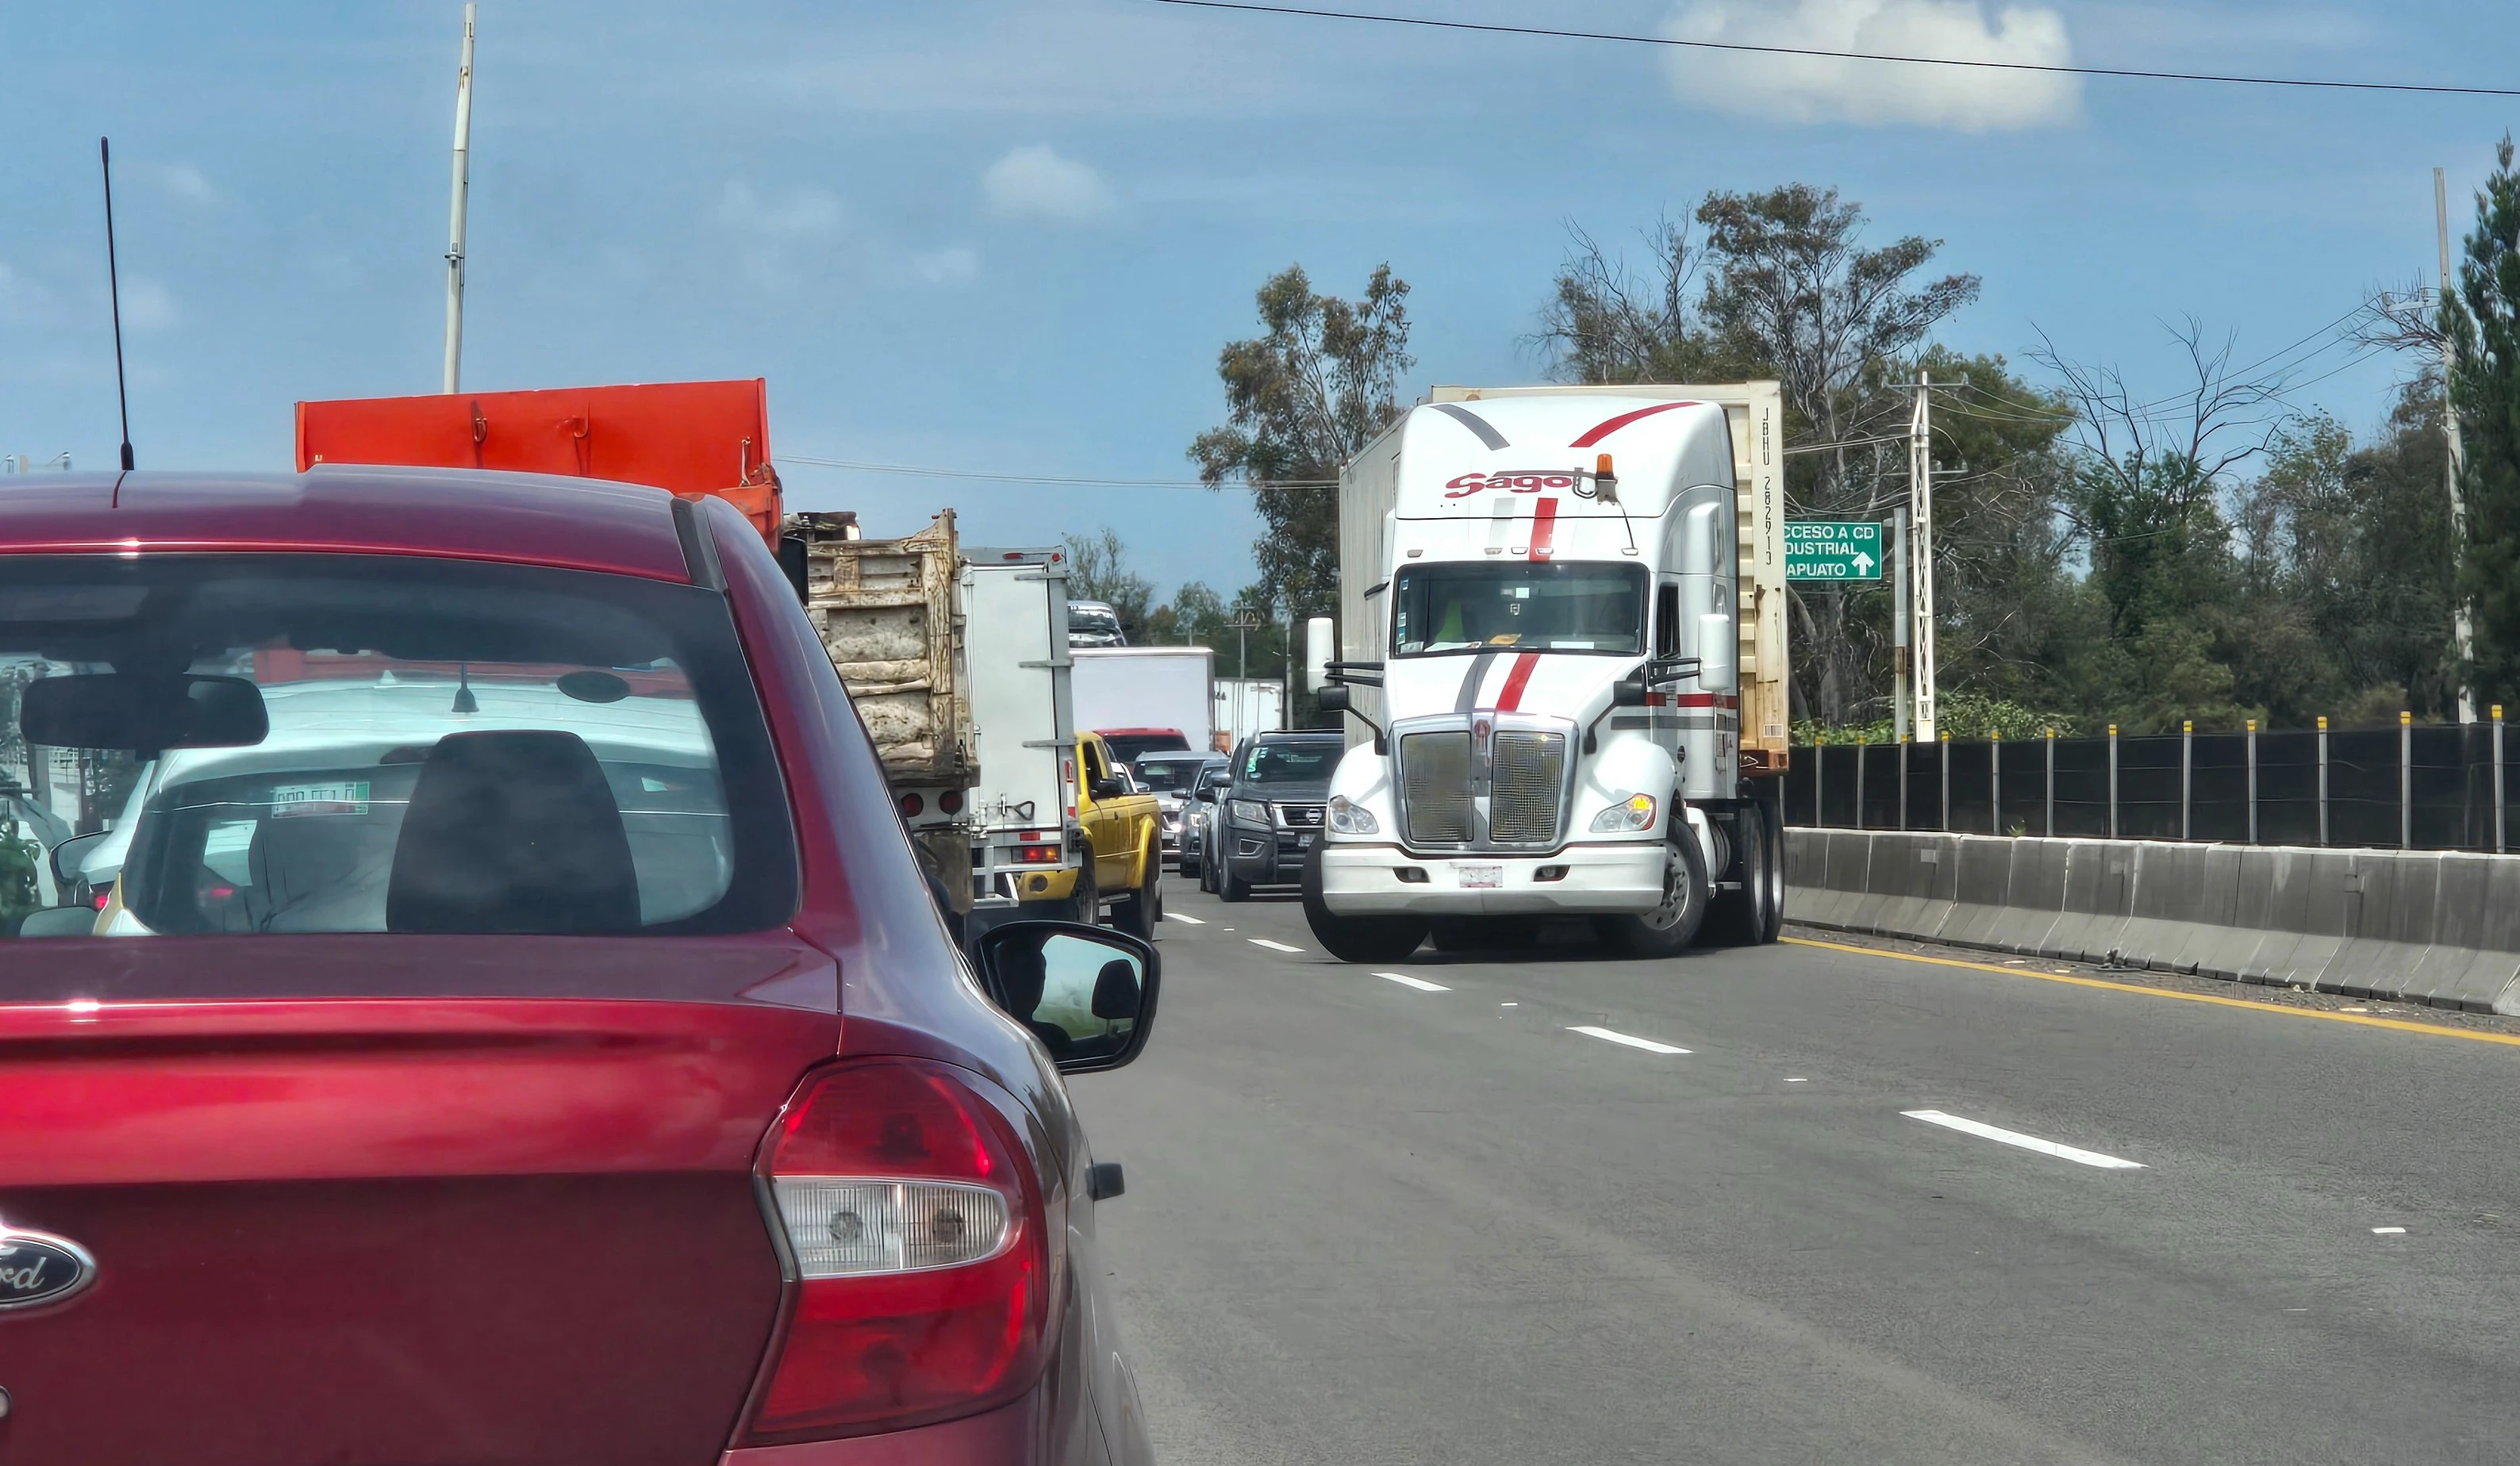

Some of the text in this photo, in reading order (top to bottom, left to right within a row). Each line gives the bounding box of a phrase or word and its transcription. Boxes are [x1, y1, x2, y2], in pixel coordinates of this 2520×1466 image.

[1784, 525, 1874, 539] CCESO A CD
[1784, 542, 1859, 555] DUSTRIAL
[1786, 562, 1846, 577] APUATO
